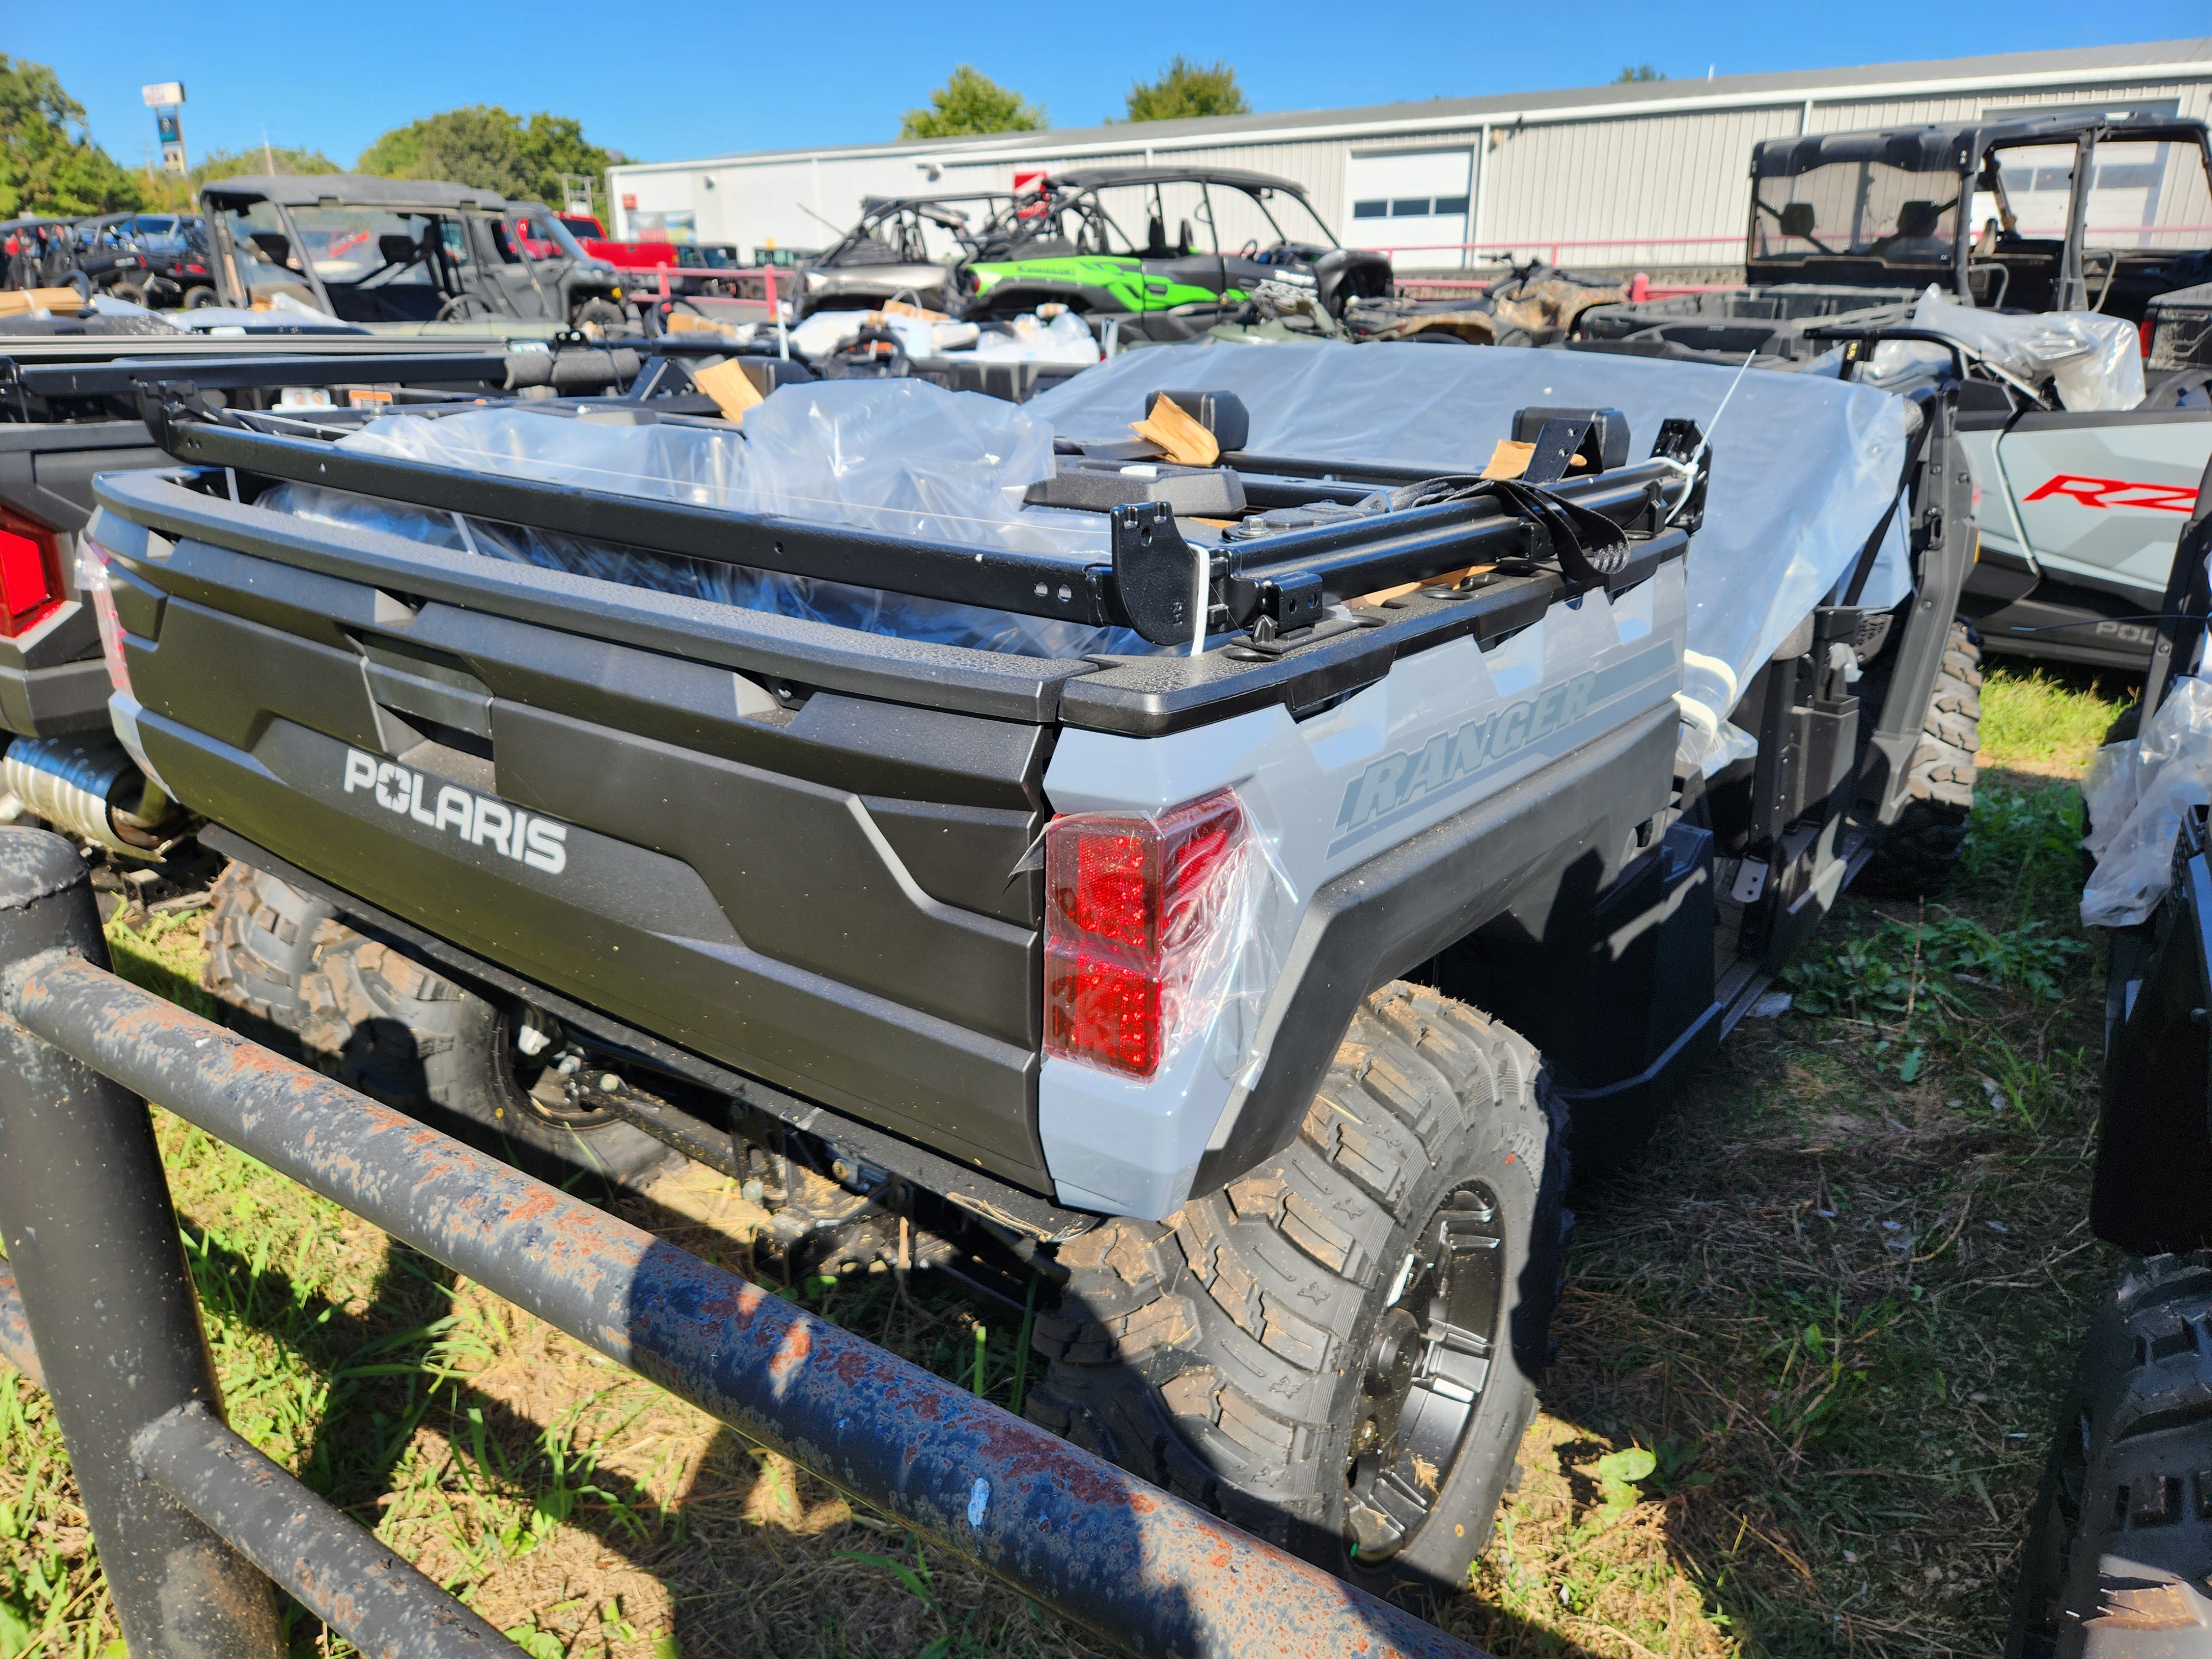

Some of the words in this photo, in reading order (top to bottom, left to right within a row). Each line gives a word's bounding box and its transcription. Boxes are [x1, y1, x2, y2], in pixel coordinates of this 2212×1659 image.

[2021, 474, 2199, 513] RZ
[2095, 620, 2156, 646] POL
[1345, 670, 1597, 831] RANGER
[343, 747, 567, 875] POLARIS
